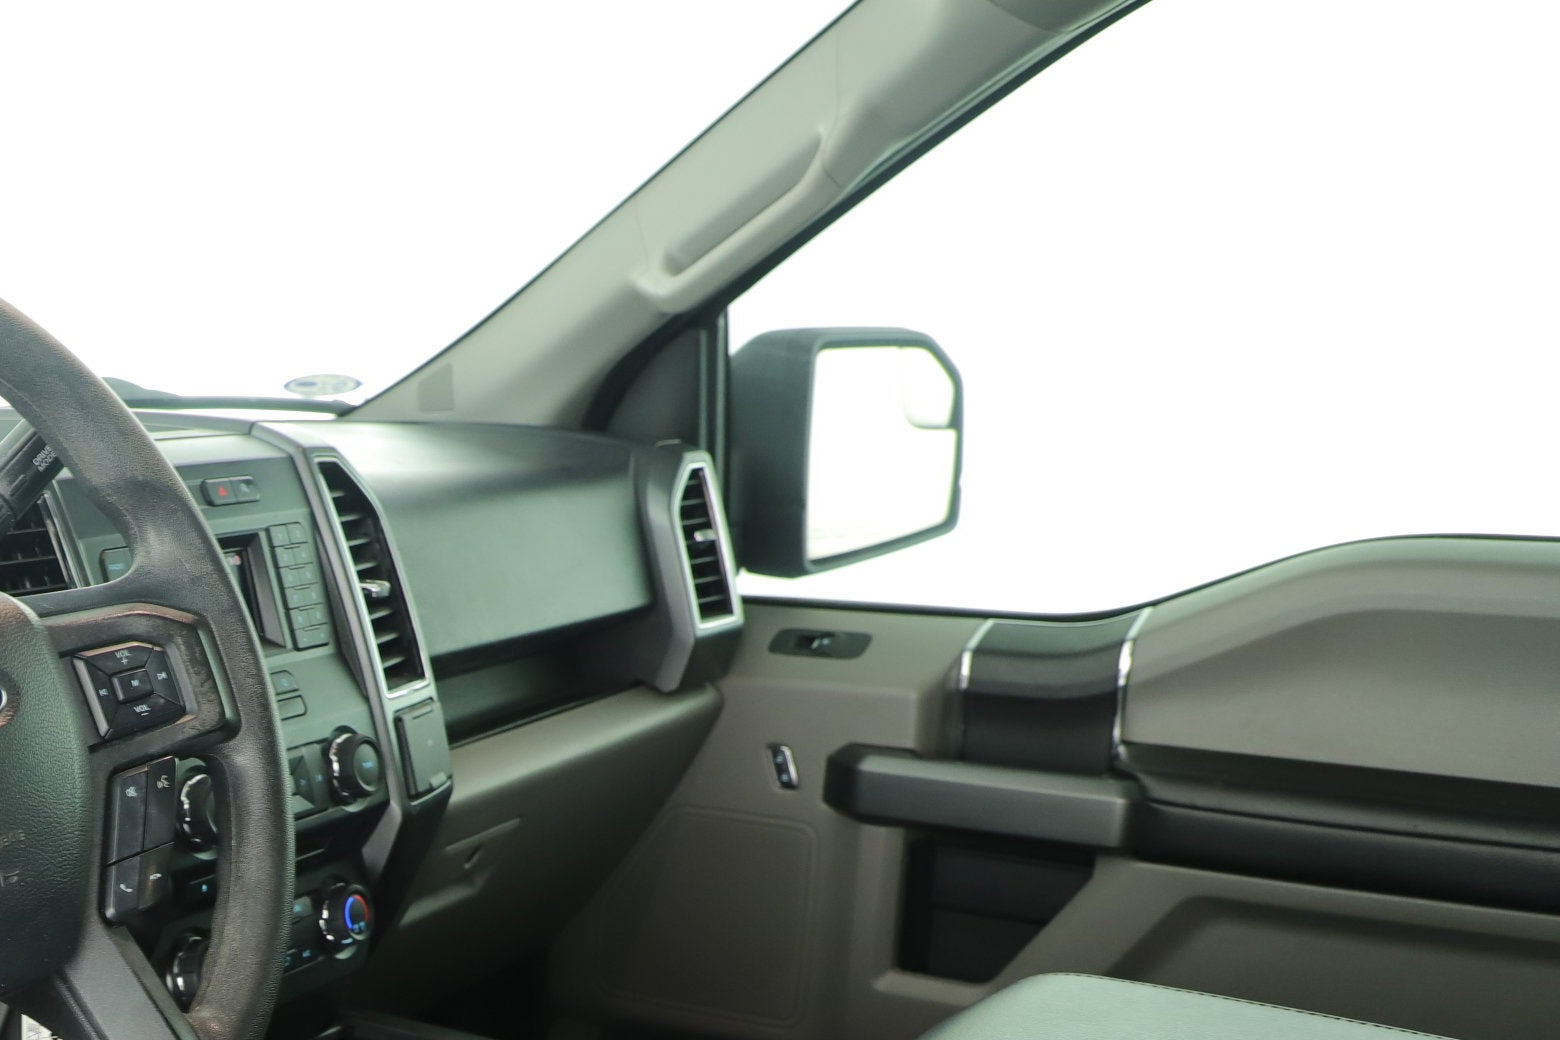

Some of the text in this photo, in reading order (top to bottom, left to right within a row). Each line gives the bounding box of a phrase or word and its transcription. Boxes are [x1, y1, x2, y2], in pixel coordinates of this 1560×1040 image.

[32, 445, 53, 466] DRIVE
[37, 450, 57, 473] MODE
[114, 649, 132, 659] VOL
[133, 703, 152, 713] VOL
